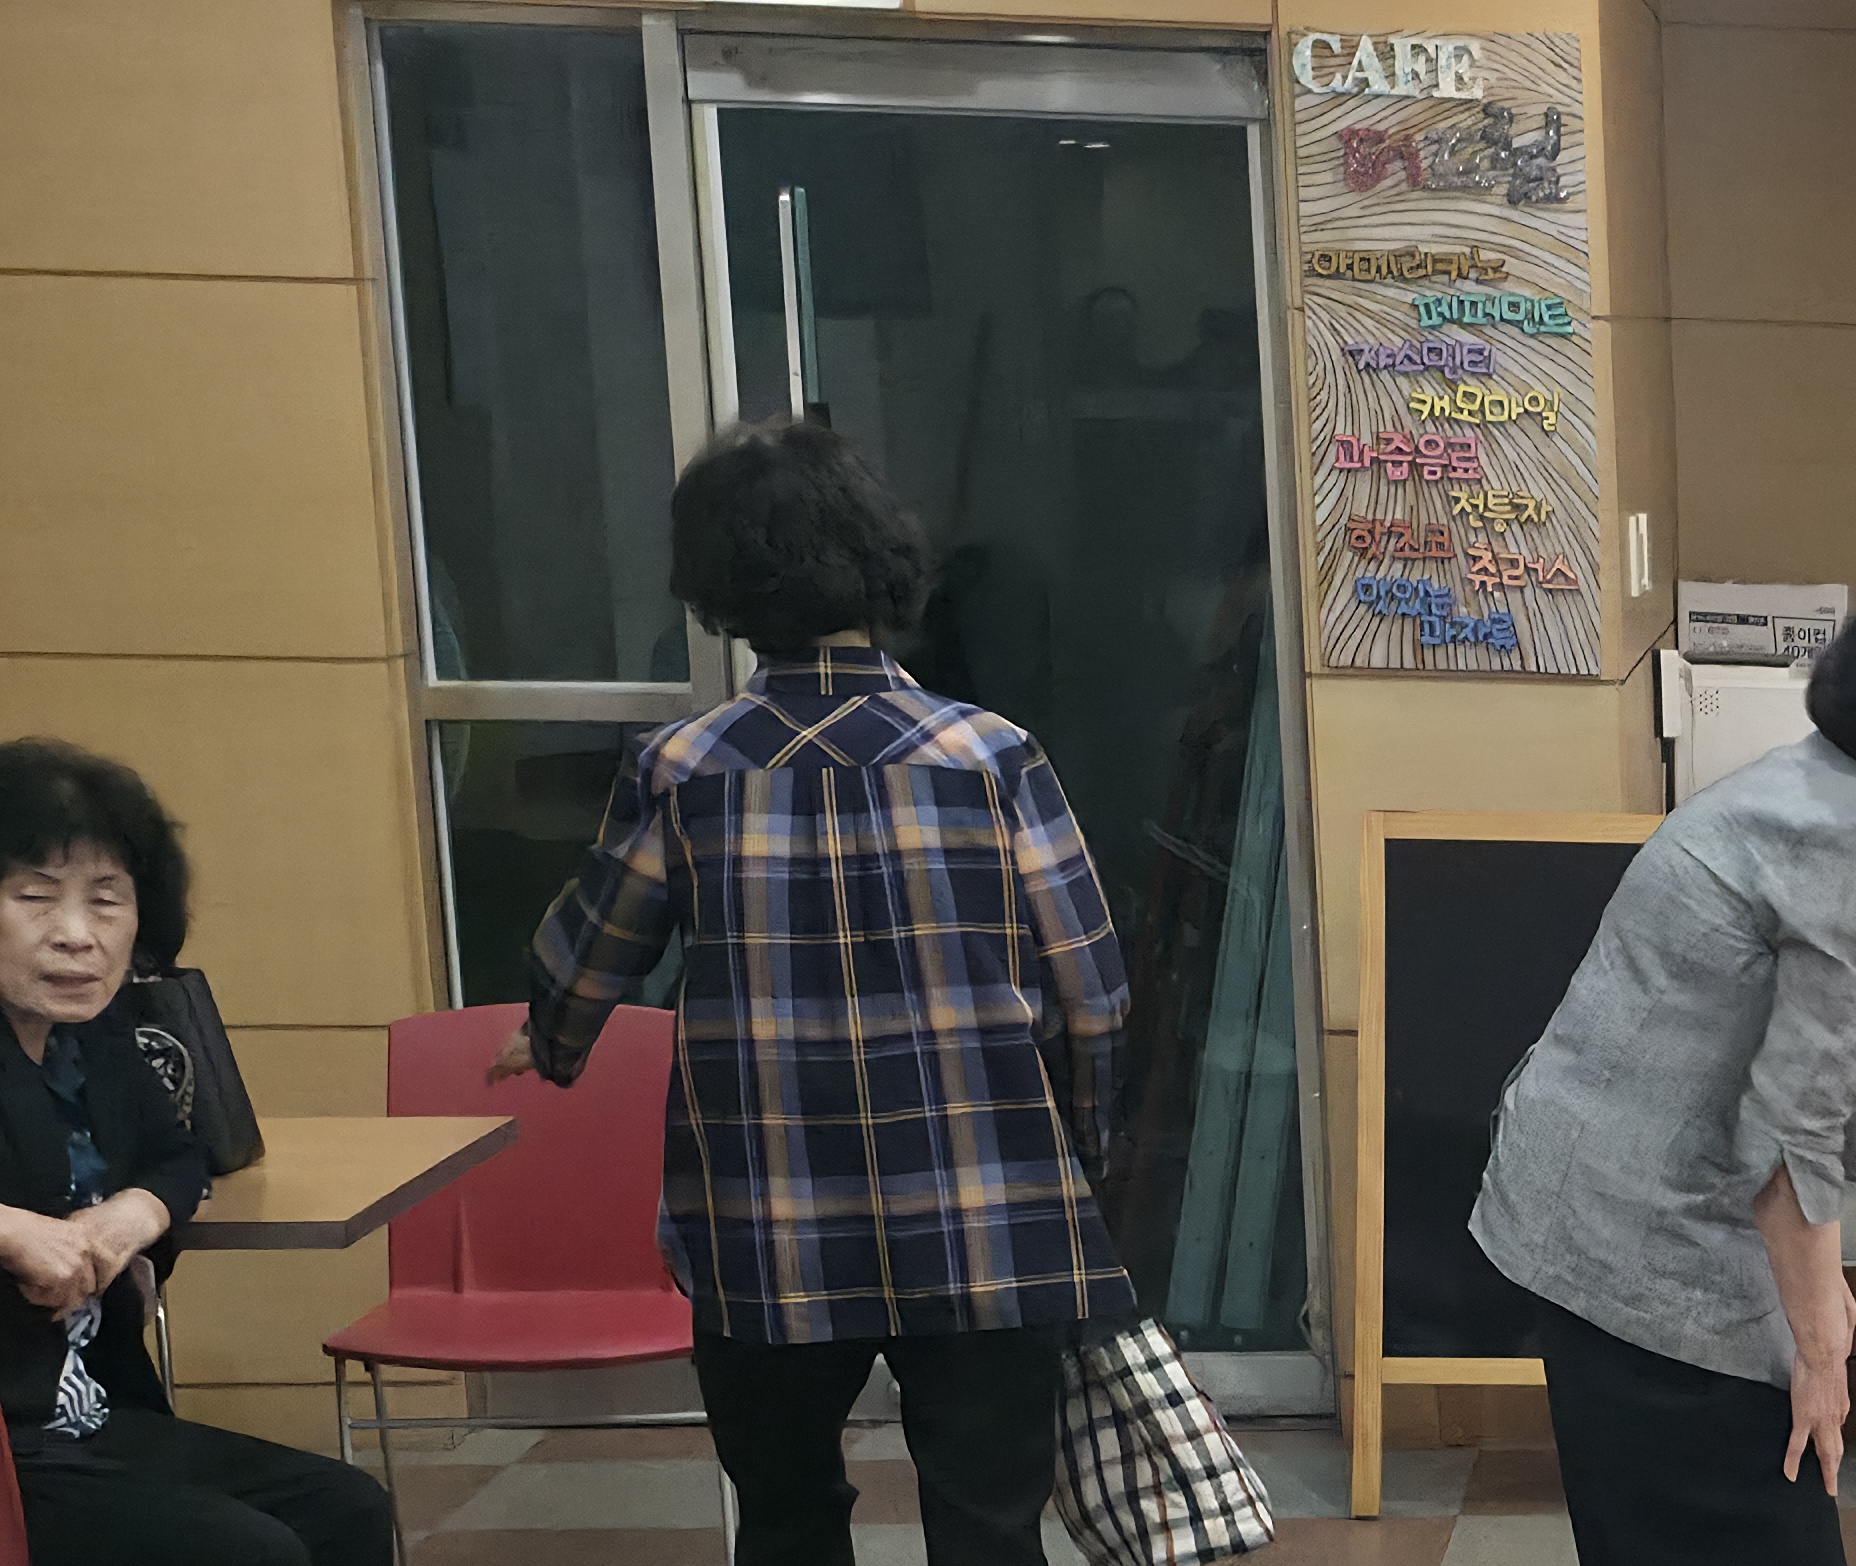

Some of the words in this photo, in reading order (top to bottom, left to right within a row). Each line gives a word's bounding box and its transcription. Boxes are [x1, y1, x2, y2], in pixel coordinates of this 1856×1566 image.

[1292, 32, 1487, 99] CAFE
[1311, 245, 1508, 282] 아메리카노
[1412, 293, 1574, 336] 페퍼민트
[1409, 384, 1560, 431] 캐모마일
[1334, 431, 1482, 481] 과즙음료
[1450, 490, 1554, 532] 전통차
[1347, 518, 1456, 559] 핫초코
[1465, 541, 1581, 592] 츄러스
[1356, 575, 1456, 616] 맛있는
